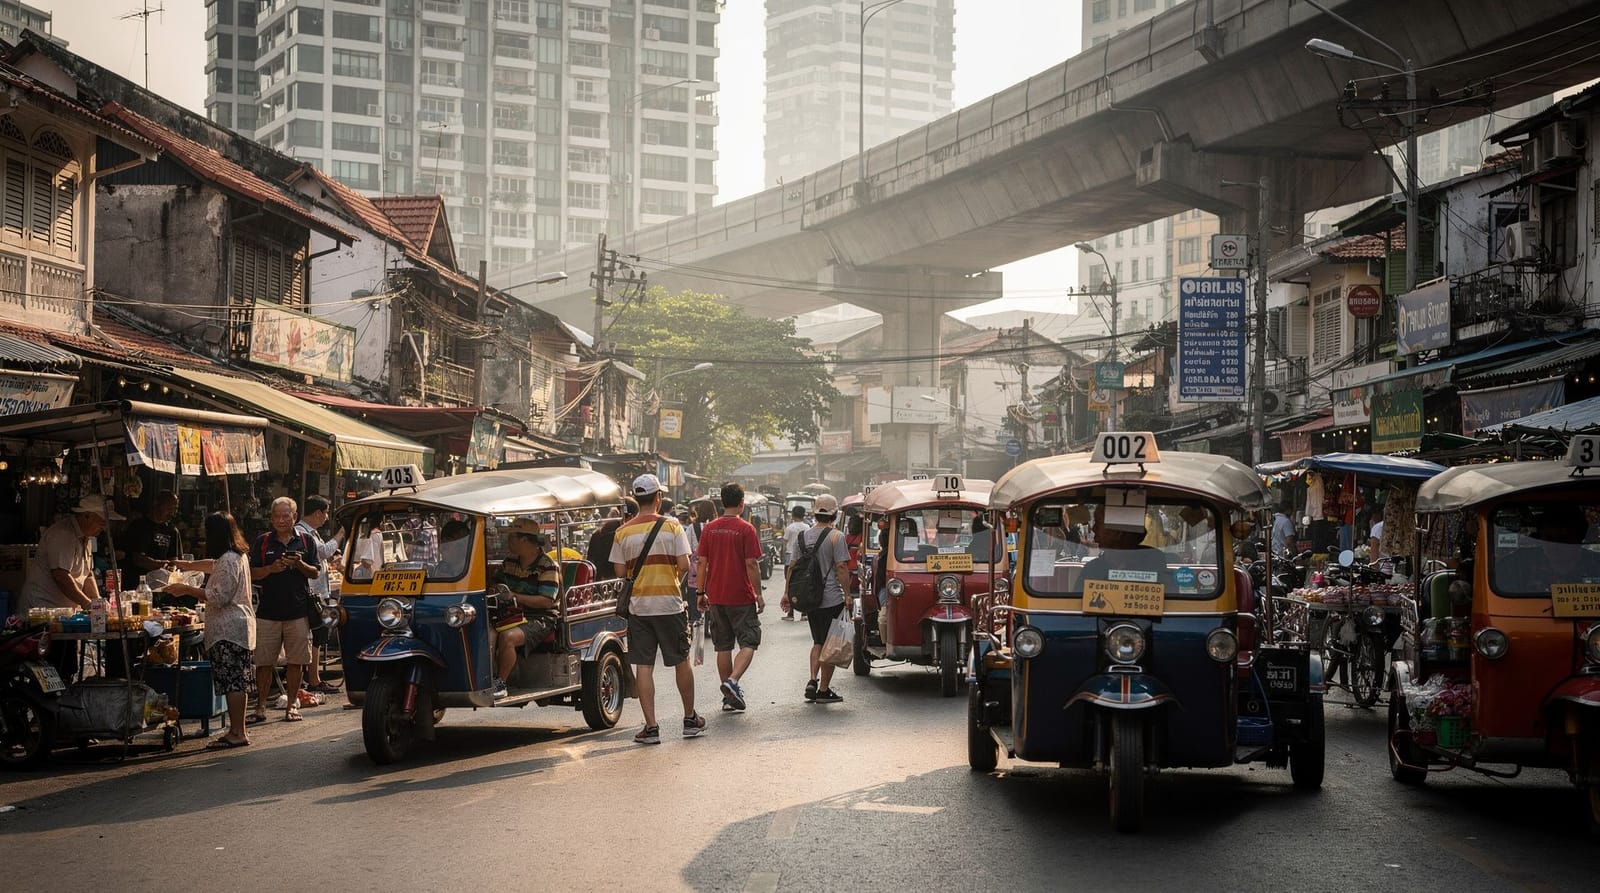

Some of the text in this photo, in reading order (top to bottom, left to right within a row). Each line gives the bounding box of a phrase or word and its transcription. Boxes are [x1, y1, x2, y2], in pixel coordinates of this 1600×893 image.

[1103, 435, 1146, 459] 002
[1580, 438, 1600, 464] 3
[944, 476, 959, 490] 10
